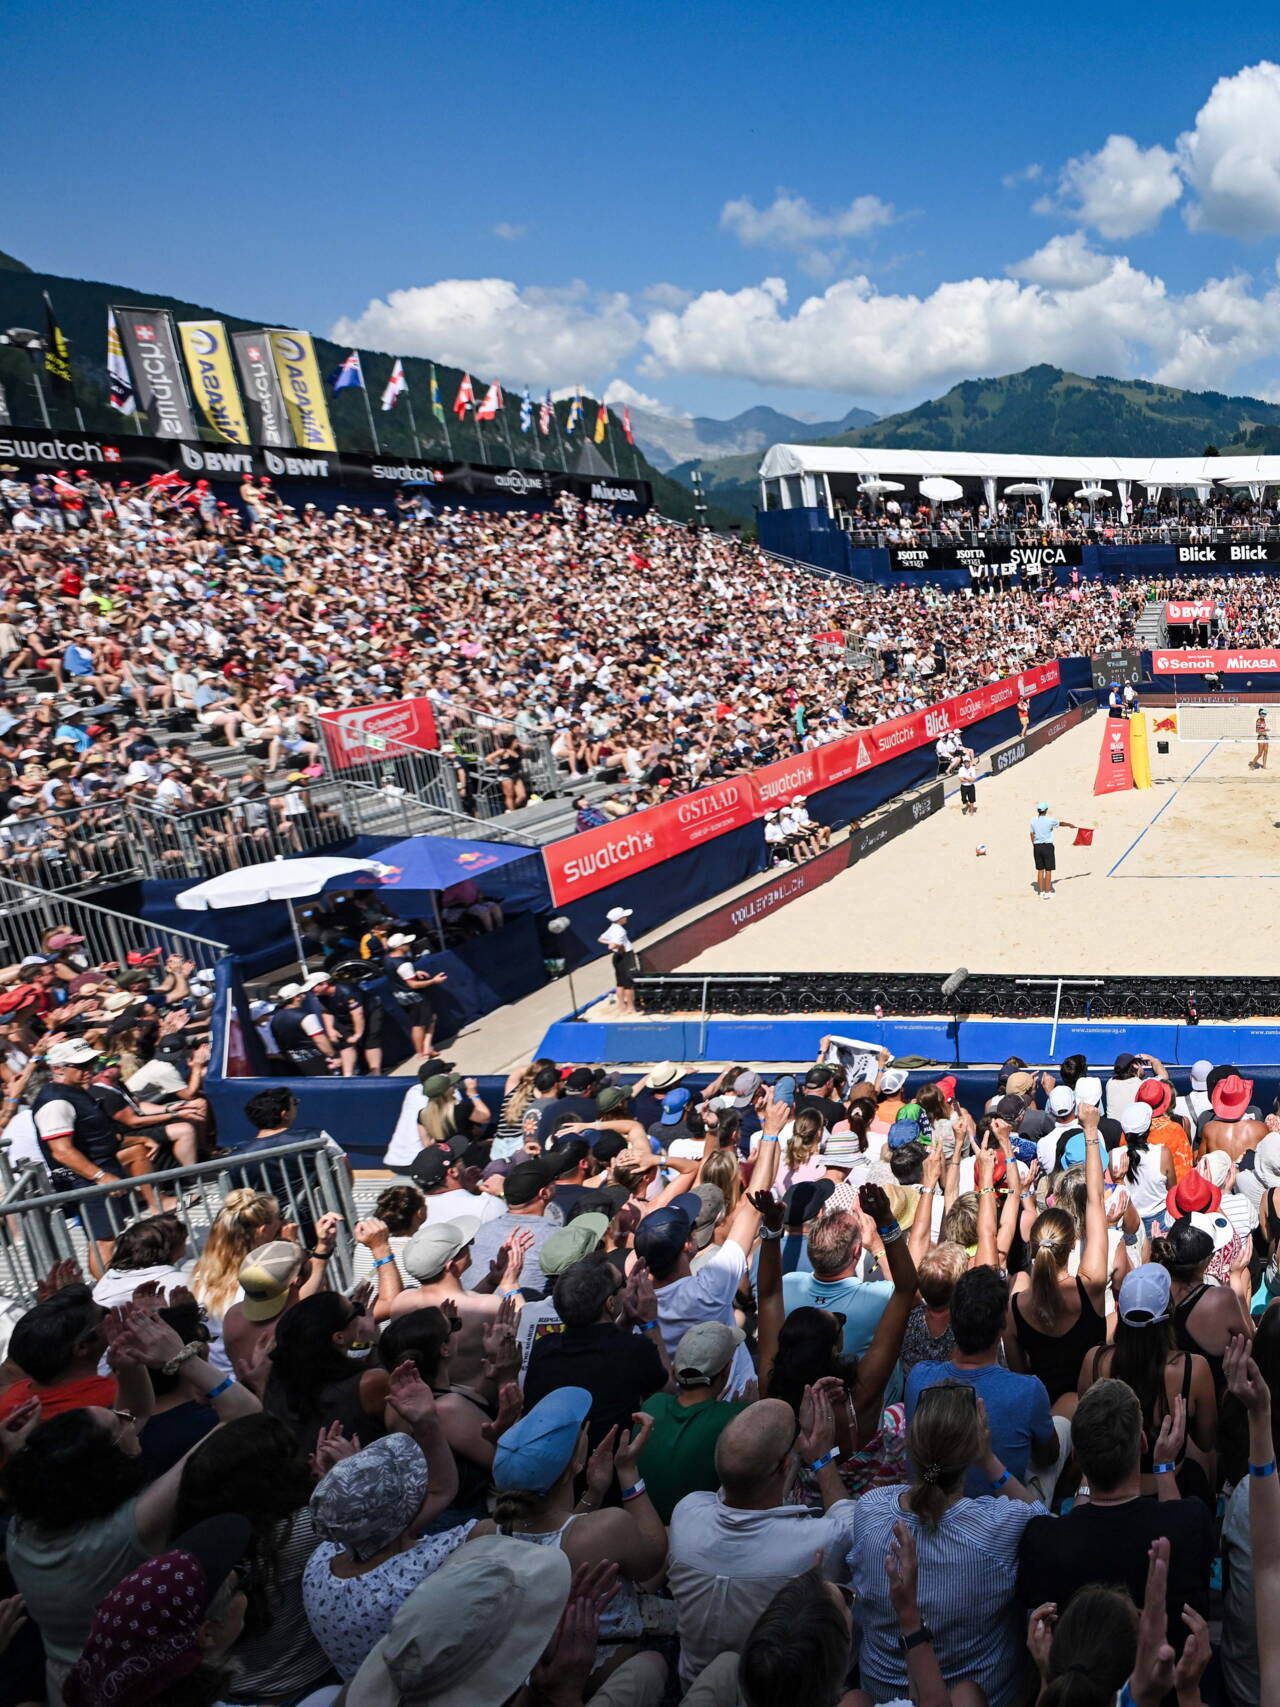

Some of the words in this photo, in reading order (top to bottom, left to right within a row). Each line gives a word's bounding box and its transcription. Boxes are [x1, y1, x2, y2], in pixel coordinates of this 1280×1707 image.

[0, 439, 104, 462] swatch
[204, 452, 253, 472] BWT
[285, 457, 329, 477] BWT
[372, 464, 434, 482] swatch
[1179, 547, 1216, 562] Blick
[1230, 545, 1267, 560] Blick
[1182, 606, 1211, 618] BWT
[1170, 659, 1215, 669] Senoh
[925, 708, 950, 737] Blick
[879, 728, 911, 751] swatch
[759, 769, 807, 801] swatch
[678, 787, 738, 824] GSTAAD
[564, 832, 643, 883] swatch
